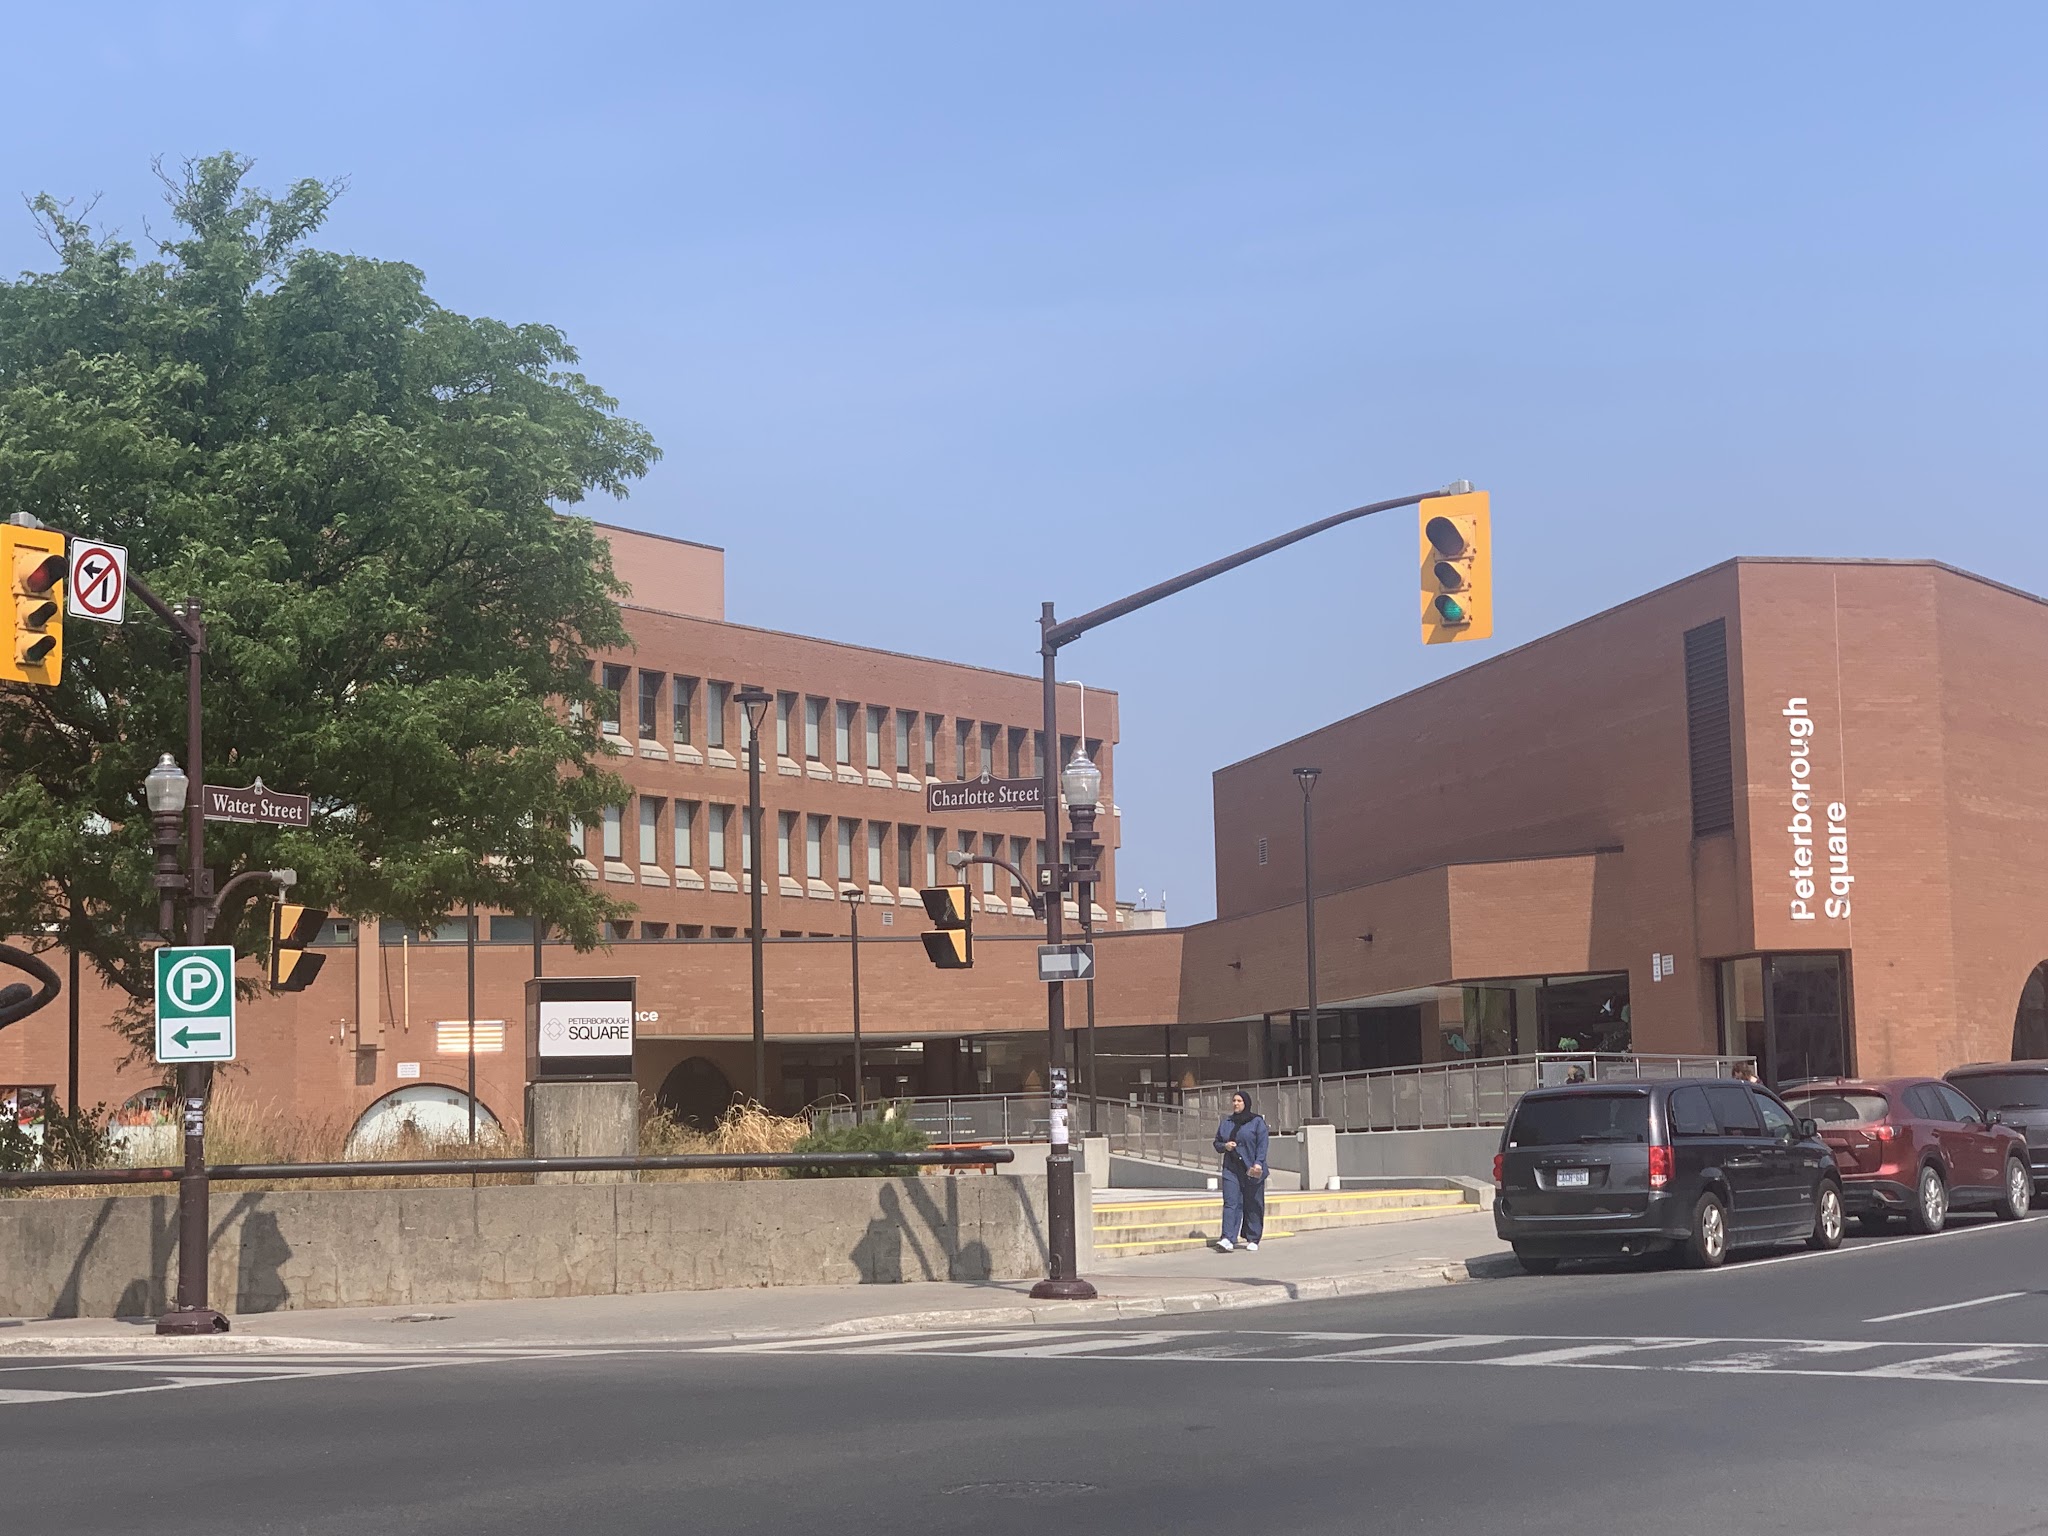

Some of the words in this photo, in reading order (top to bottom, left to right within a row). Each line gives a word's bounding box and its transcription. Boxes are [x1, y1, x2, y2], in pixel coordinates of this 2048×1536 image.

[212, 793, 257, 815] Water
[260, 798, 303, 820] Street
[932, 787, 995, 807] Charlotte
[999, 785, 1040, 803] Street
[1782, 697, 1815, 920] Peterborough
[1824, 802, 1855, 919] Square
[182, 967, 212, 1001] P
[568, 1017, 630, 1025] PETERBOROUGH
[568, 1026, 630, 1041] SQUARE
